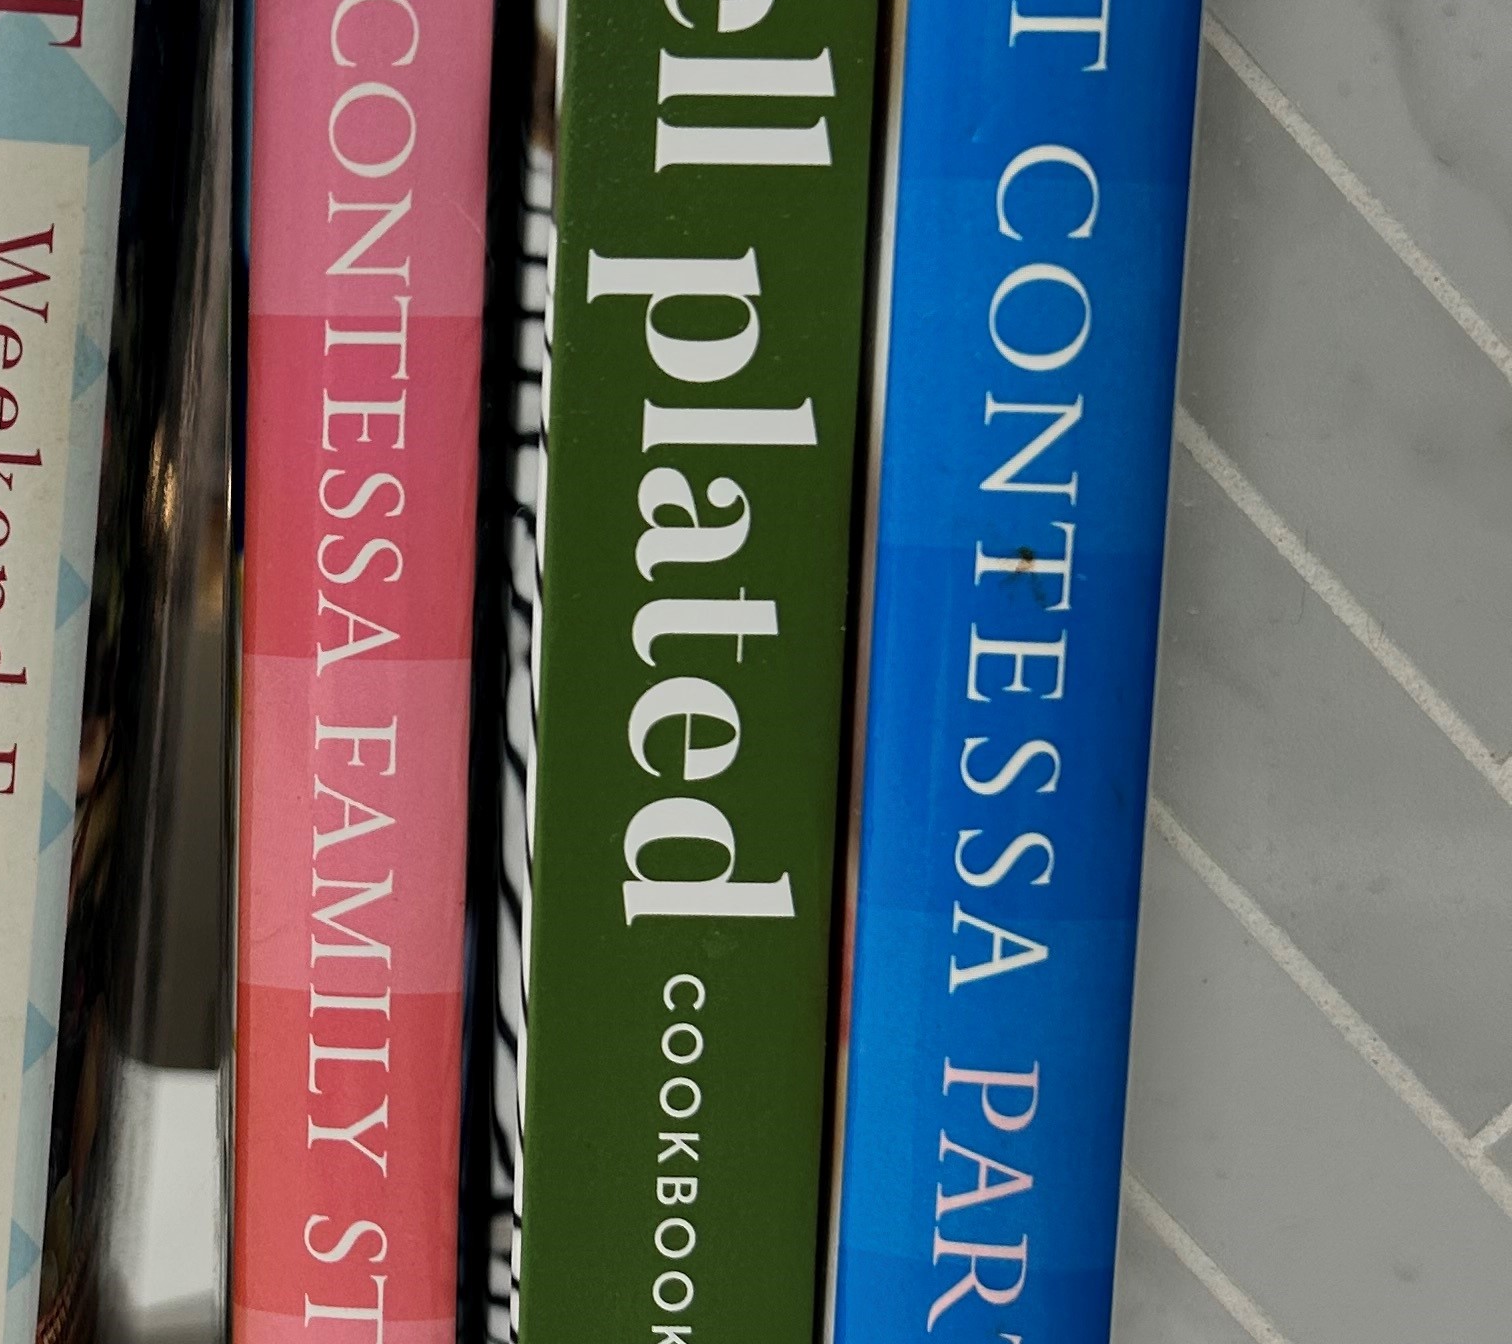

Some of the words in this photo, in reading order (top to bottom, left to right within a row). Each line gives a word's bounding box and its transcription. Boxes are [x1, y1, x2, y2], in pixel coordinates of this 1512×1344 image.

[586, 248, 819, 927] plated
[948, 143, 1101, 994] CONTESSA
[305, 715, 399, 1178] FAMILY
